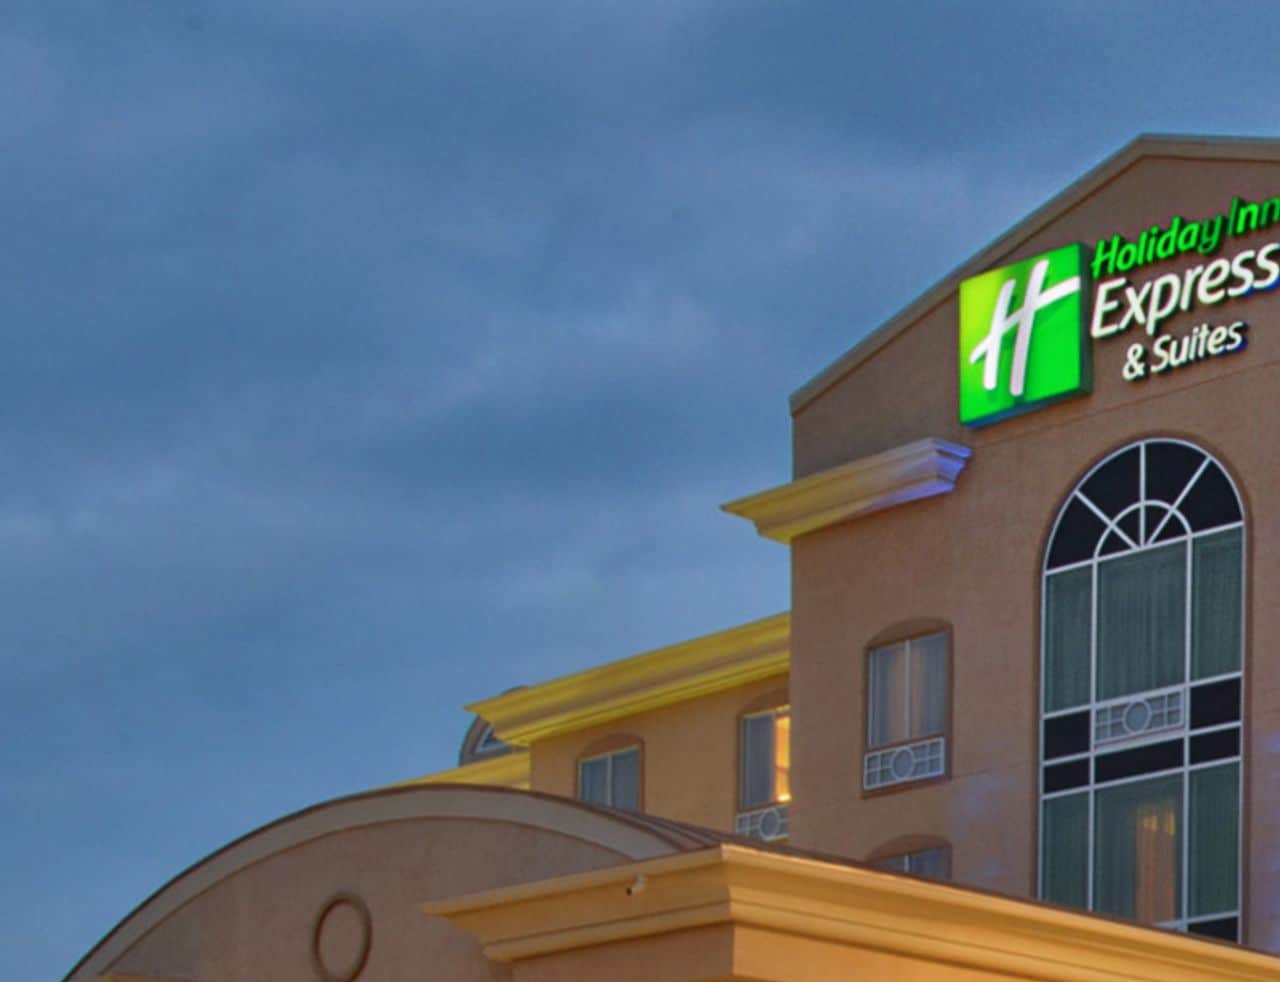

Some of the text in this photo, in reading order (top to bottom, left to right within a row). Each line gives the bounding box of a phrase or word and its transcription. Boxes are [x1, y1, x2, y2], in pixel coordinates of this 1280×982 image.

[1091, 215, 1224, 279] Holiday
[1122, 321, 1244, 380] & Suites
